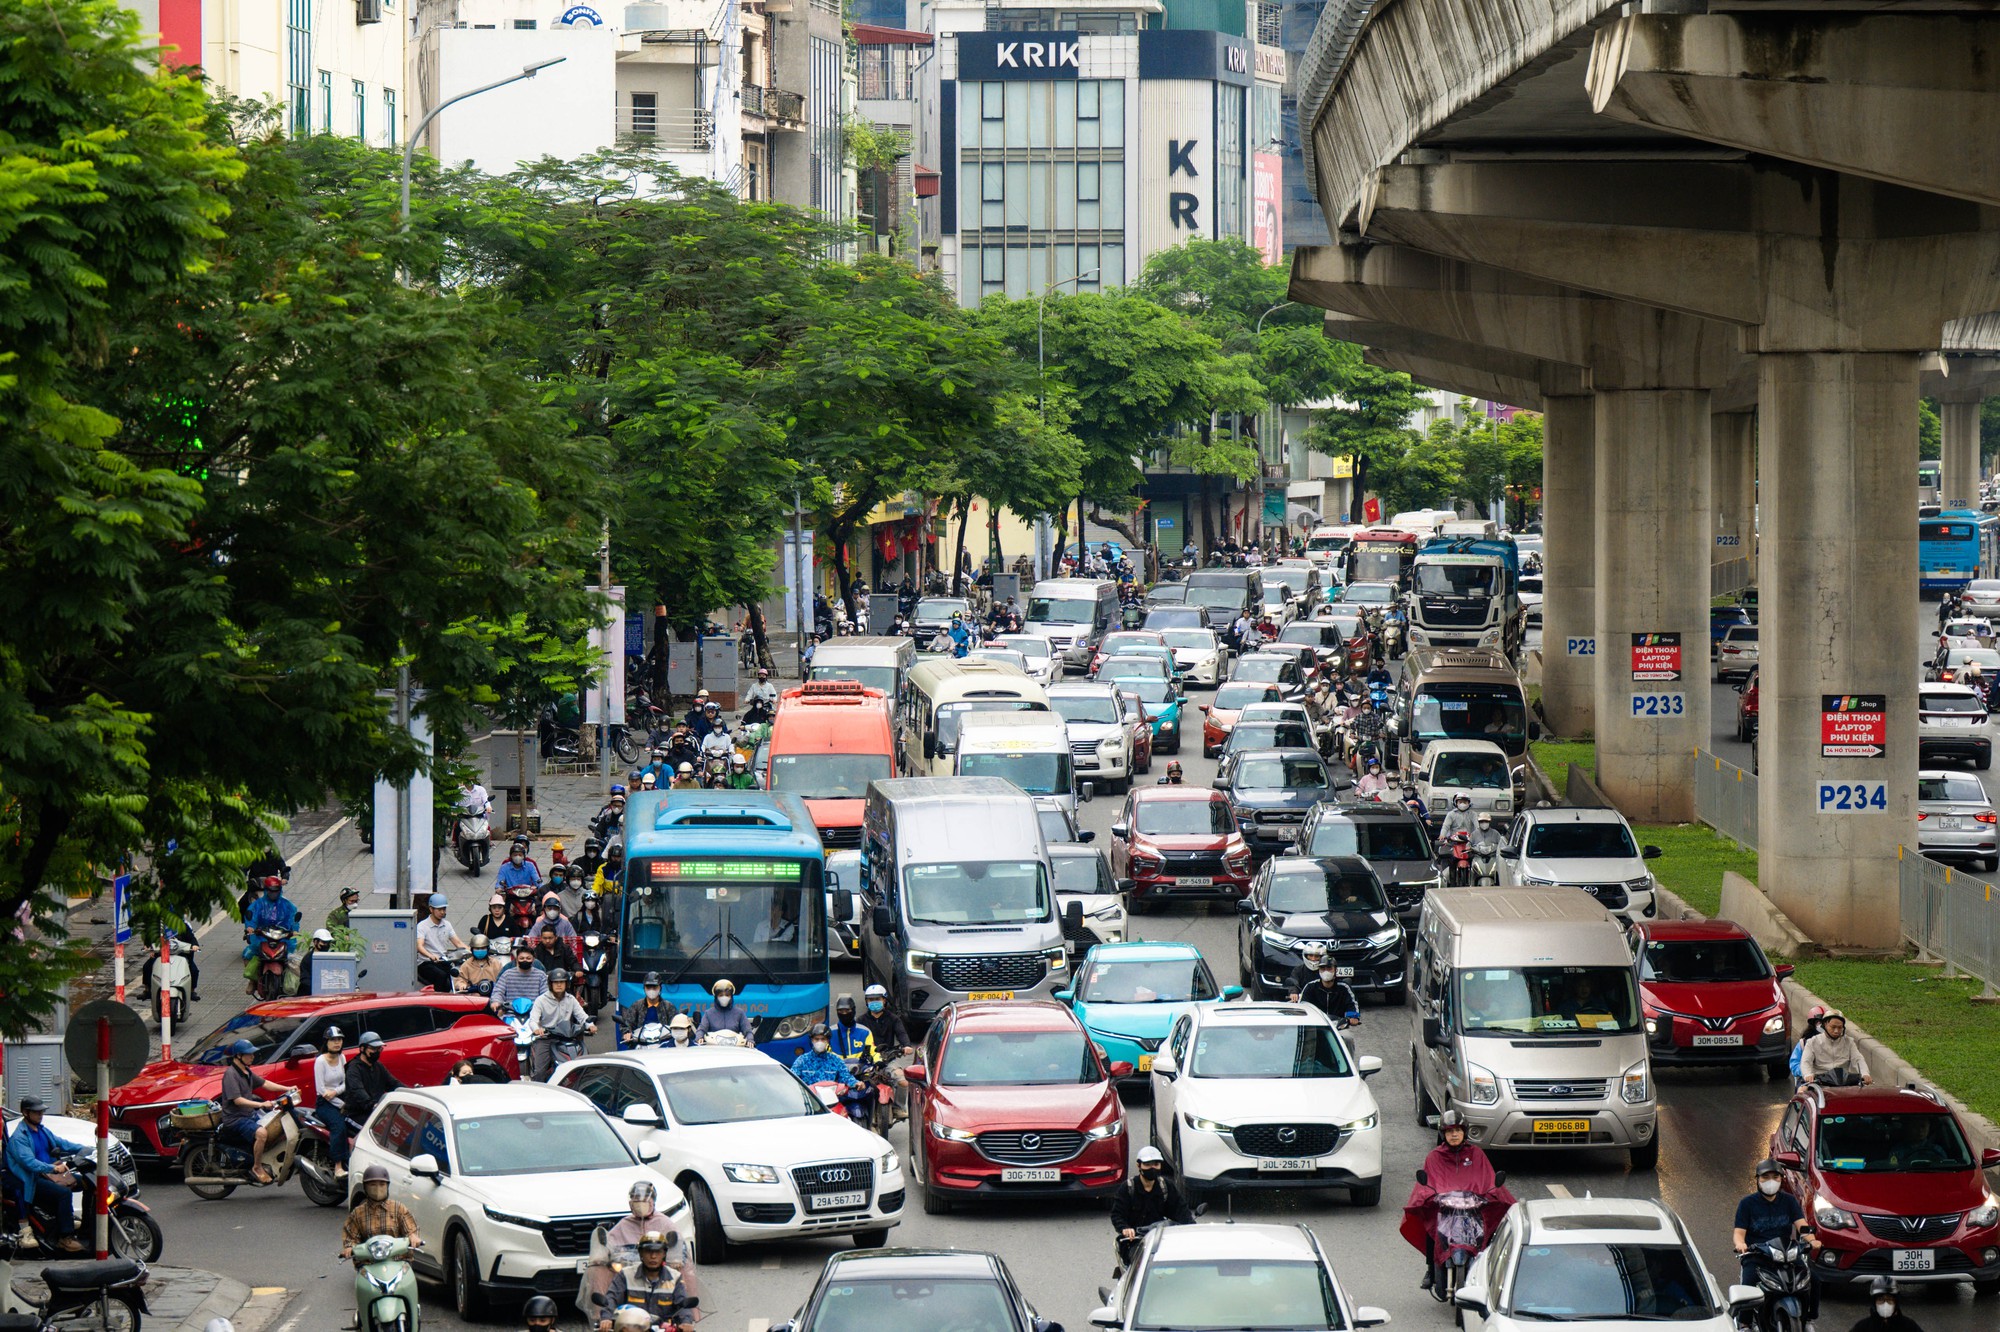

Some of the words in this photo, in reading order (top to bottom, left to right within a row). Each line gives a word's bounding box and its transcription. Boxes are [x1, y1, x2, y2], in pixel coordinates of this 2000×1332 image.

[997, 42, 1079, 68] KRIK
[1228, 45, 1248, 74] KRIK
[1633, 695, 1683, 715] P233
[1826, 712, 1849, 723] ĐIỆN
[1851, 714, 1880, 723] THOẠI
[1830, 734, 1850, 743] PHỤ
[1852, 732, 1874, 743] KIỆN
[1820, 785, 1887, 809] P234
[853, 1039, 863, 1048] be
[1538, 1121, 1585, 1130] 29B-066.88
[1263, 1160, 1311, 1169] 30L-296.71
[1007, 1171, 1056, 1180] 30G-751.02
[817, 1194, 862, 1207] 29A-567.72
[1904, 1250, 1923, 1260] 30H
[1898, 1260, 1930, 1270] 359.69
